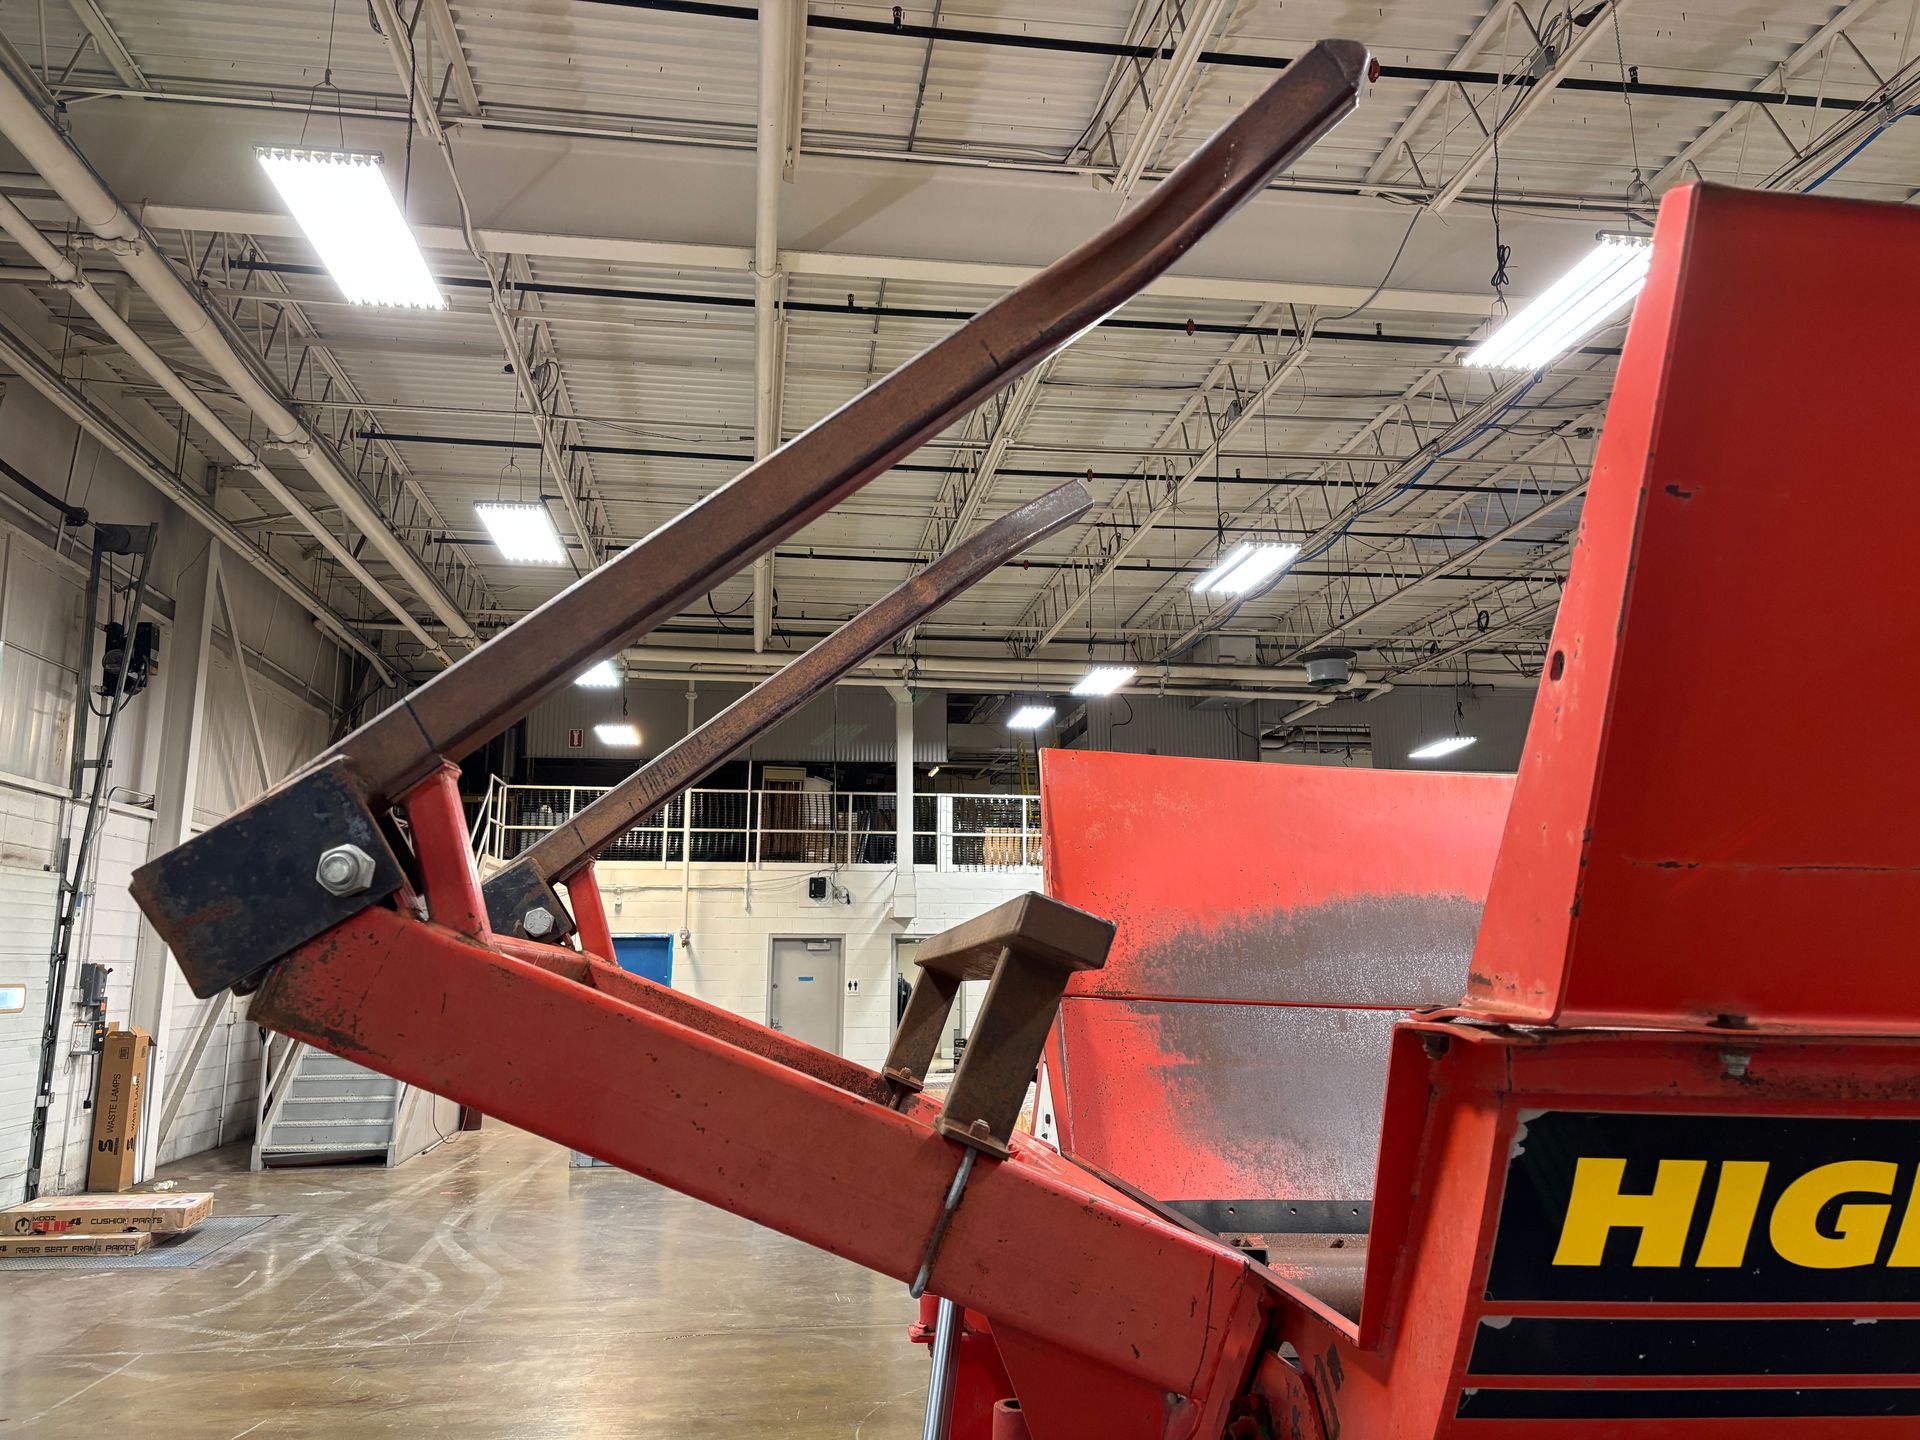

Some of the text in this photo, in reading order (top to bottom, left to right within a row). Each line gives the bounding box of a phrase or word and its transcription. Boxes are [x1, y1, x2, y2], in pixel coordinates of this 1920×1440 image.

[106, 1104, 118, 1134] WASTE
[112, 1074, 122, 1102] LAMPS
[90, 1217, 128, 1225] CUSHION
[132, 1216, 163, 1224] PARTS
[1552, 1157, 1920, 1268] HIG
[15, 1245, 40, 1254] REAR
[44, 1245, 69, 1253] SEAT
[105, 1244, 136, 1252] PARTS
